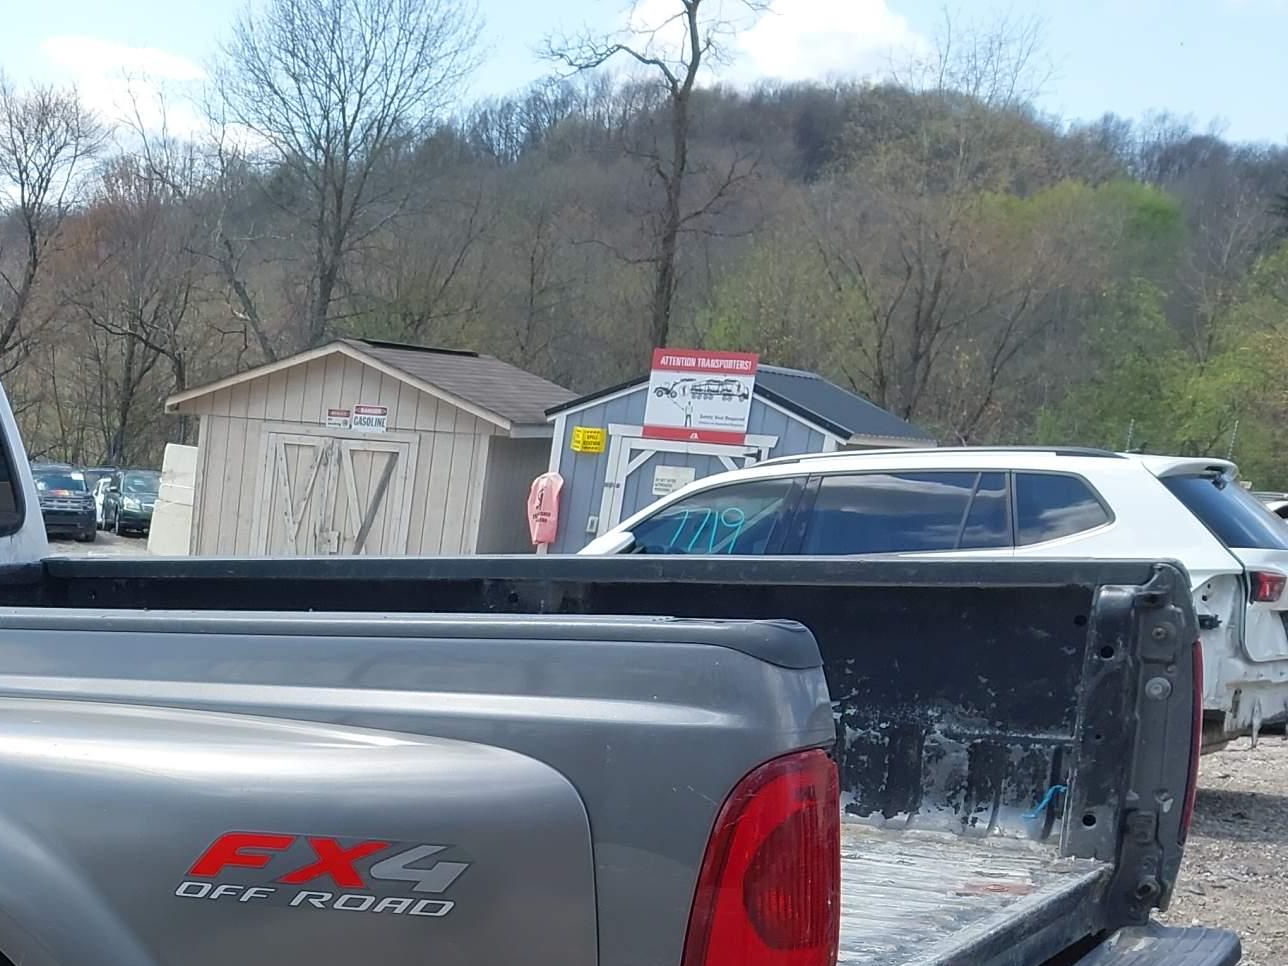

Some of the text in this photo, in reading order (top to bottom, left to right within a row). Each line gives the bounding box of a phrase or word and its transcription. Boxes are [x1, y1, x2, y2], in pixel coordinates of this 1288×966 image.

[660, 356, 752, 370] ATTENTION TRANSPORTERS!
[354, 416, 386, 428] GASOLINE
[663, 507, 745, 554] 7719
[185, 829, 470, 894] FX4
[174, 880, 456, 918] OFF ROAD
